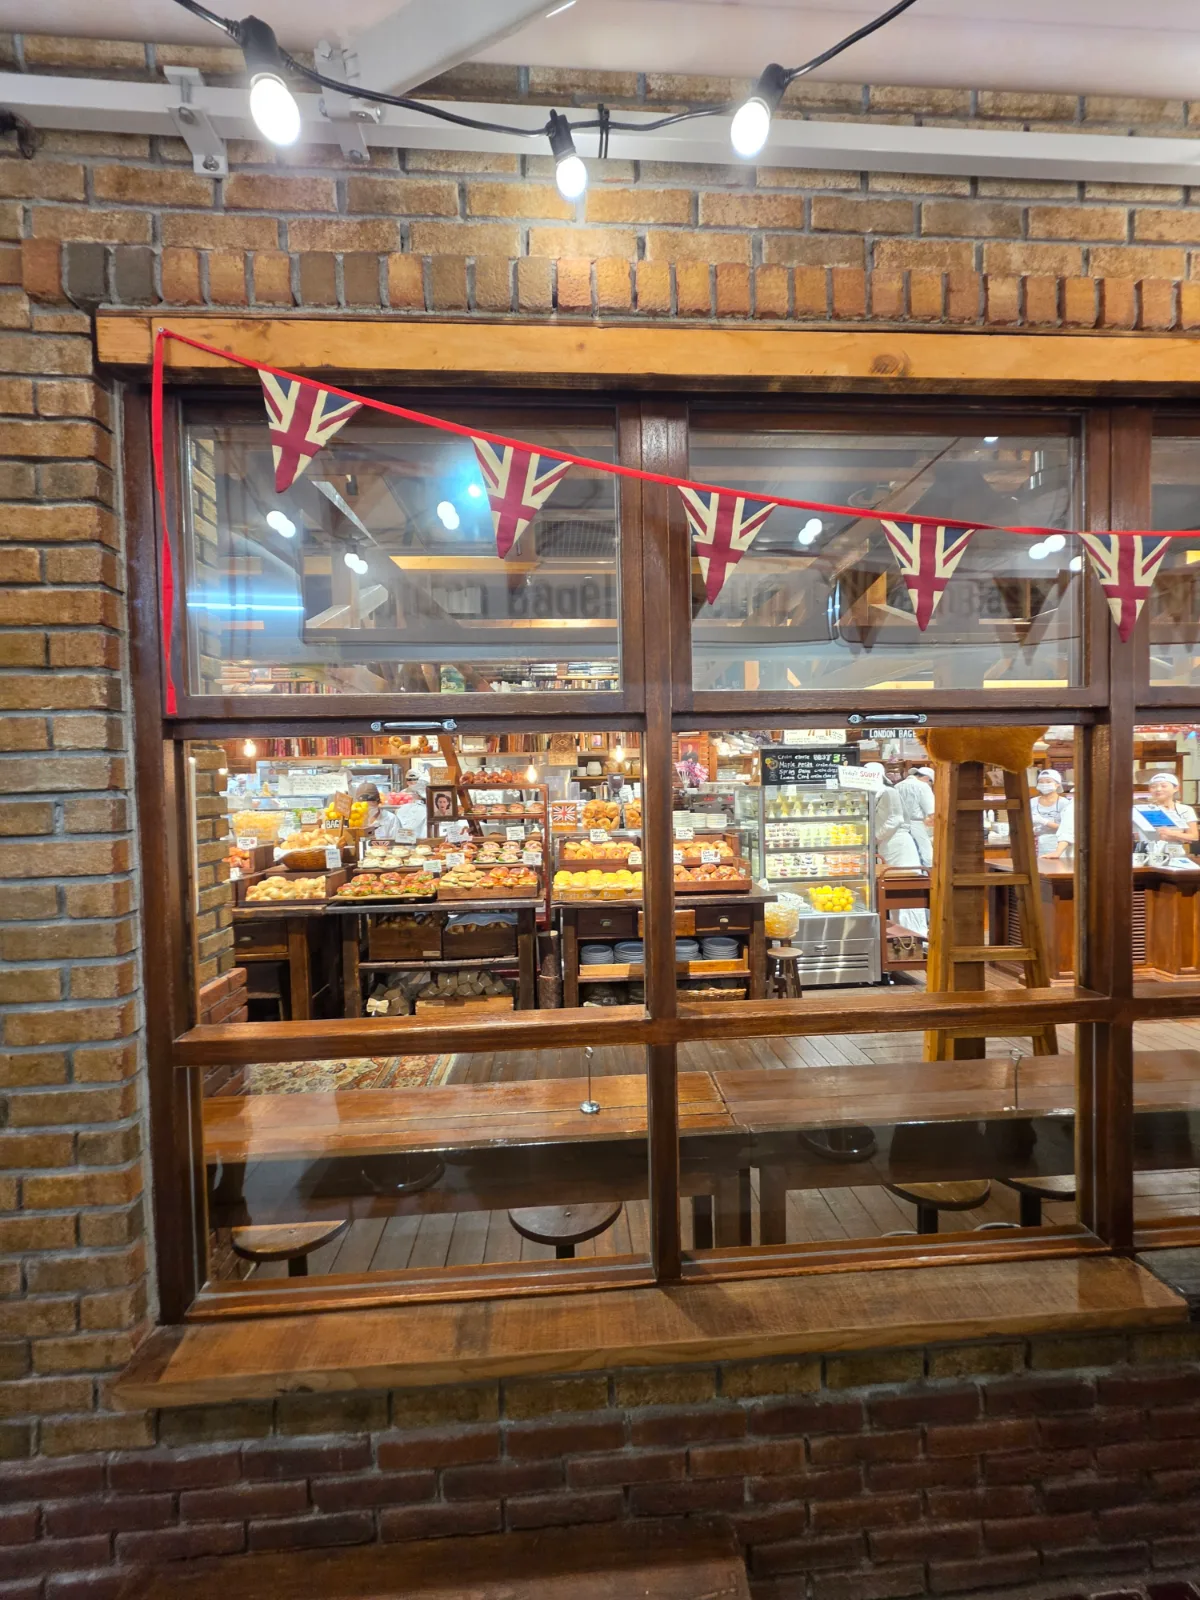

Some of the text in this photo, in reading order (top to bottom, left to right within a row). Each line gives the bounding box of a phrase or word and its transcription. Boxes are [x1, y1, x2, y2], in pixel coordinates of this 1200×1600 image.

[869, 728, 917, 738] LONDON BAGE
[832, 753, 841, 763] 3
